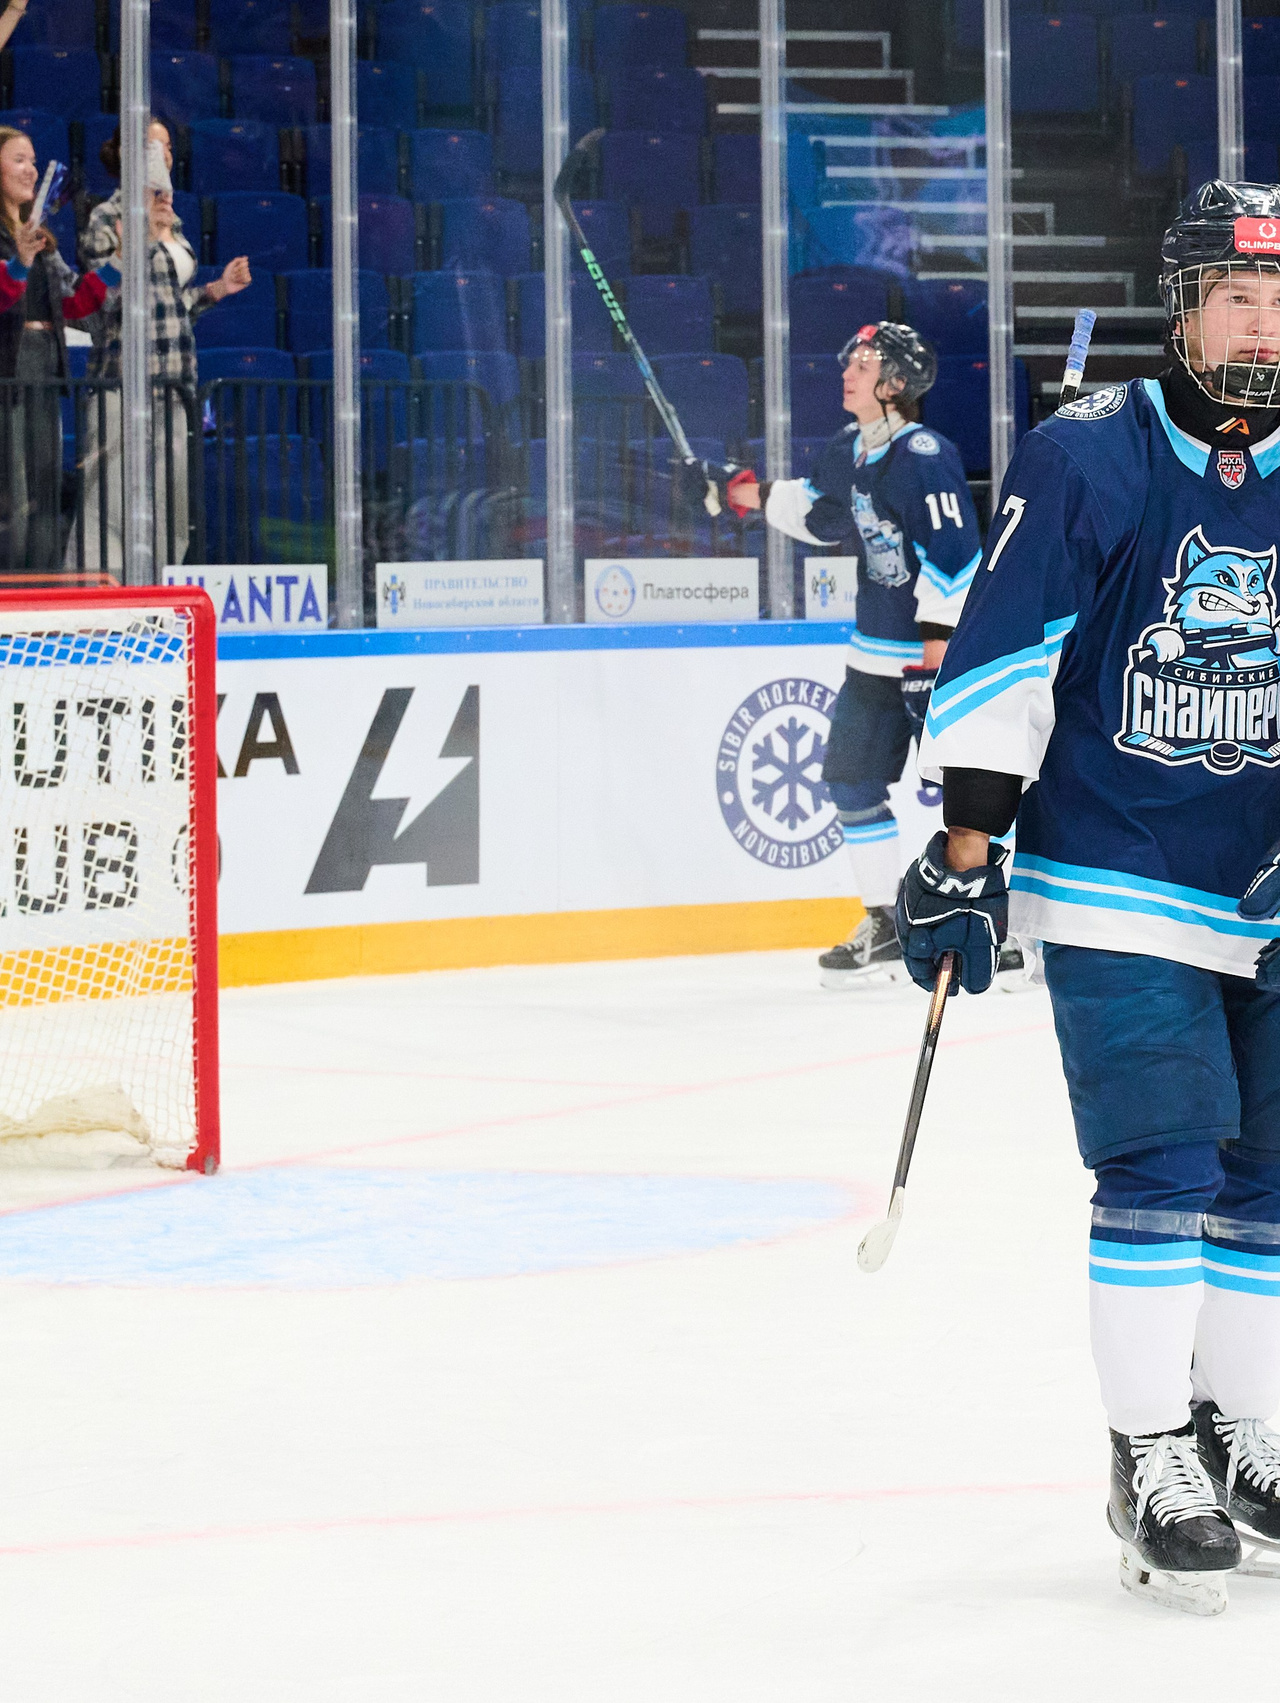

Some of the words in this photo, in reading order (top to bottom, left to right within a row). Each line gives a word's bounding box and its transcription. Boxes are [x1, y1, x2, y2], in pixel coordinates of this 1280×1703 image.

[924, 491, 964, 531] 14
[986, 494, 1028, 572] 7
[167, 575, 323, 624] ANTA
[642, 582, 750, 604] Платосфера
[1174, 667, 1275, 684] СИБИРСКИЕ
[718, 706, 756, 772] SIBIR
[756, 680, 837, 713] HOCKEY
[733, 820, 844, 868] NOVOSIBIRS
[918, 851, 987, 898] CM
